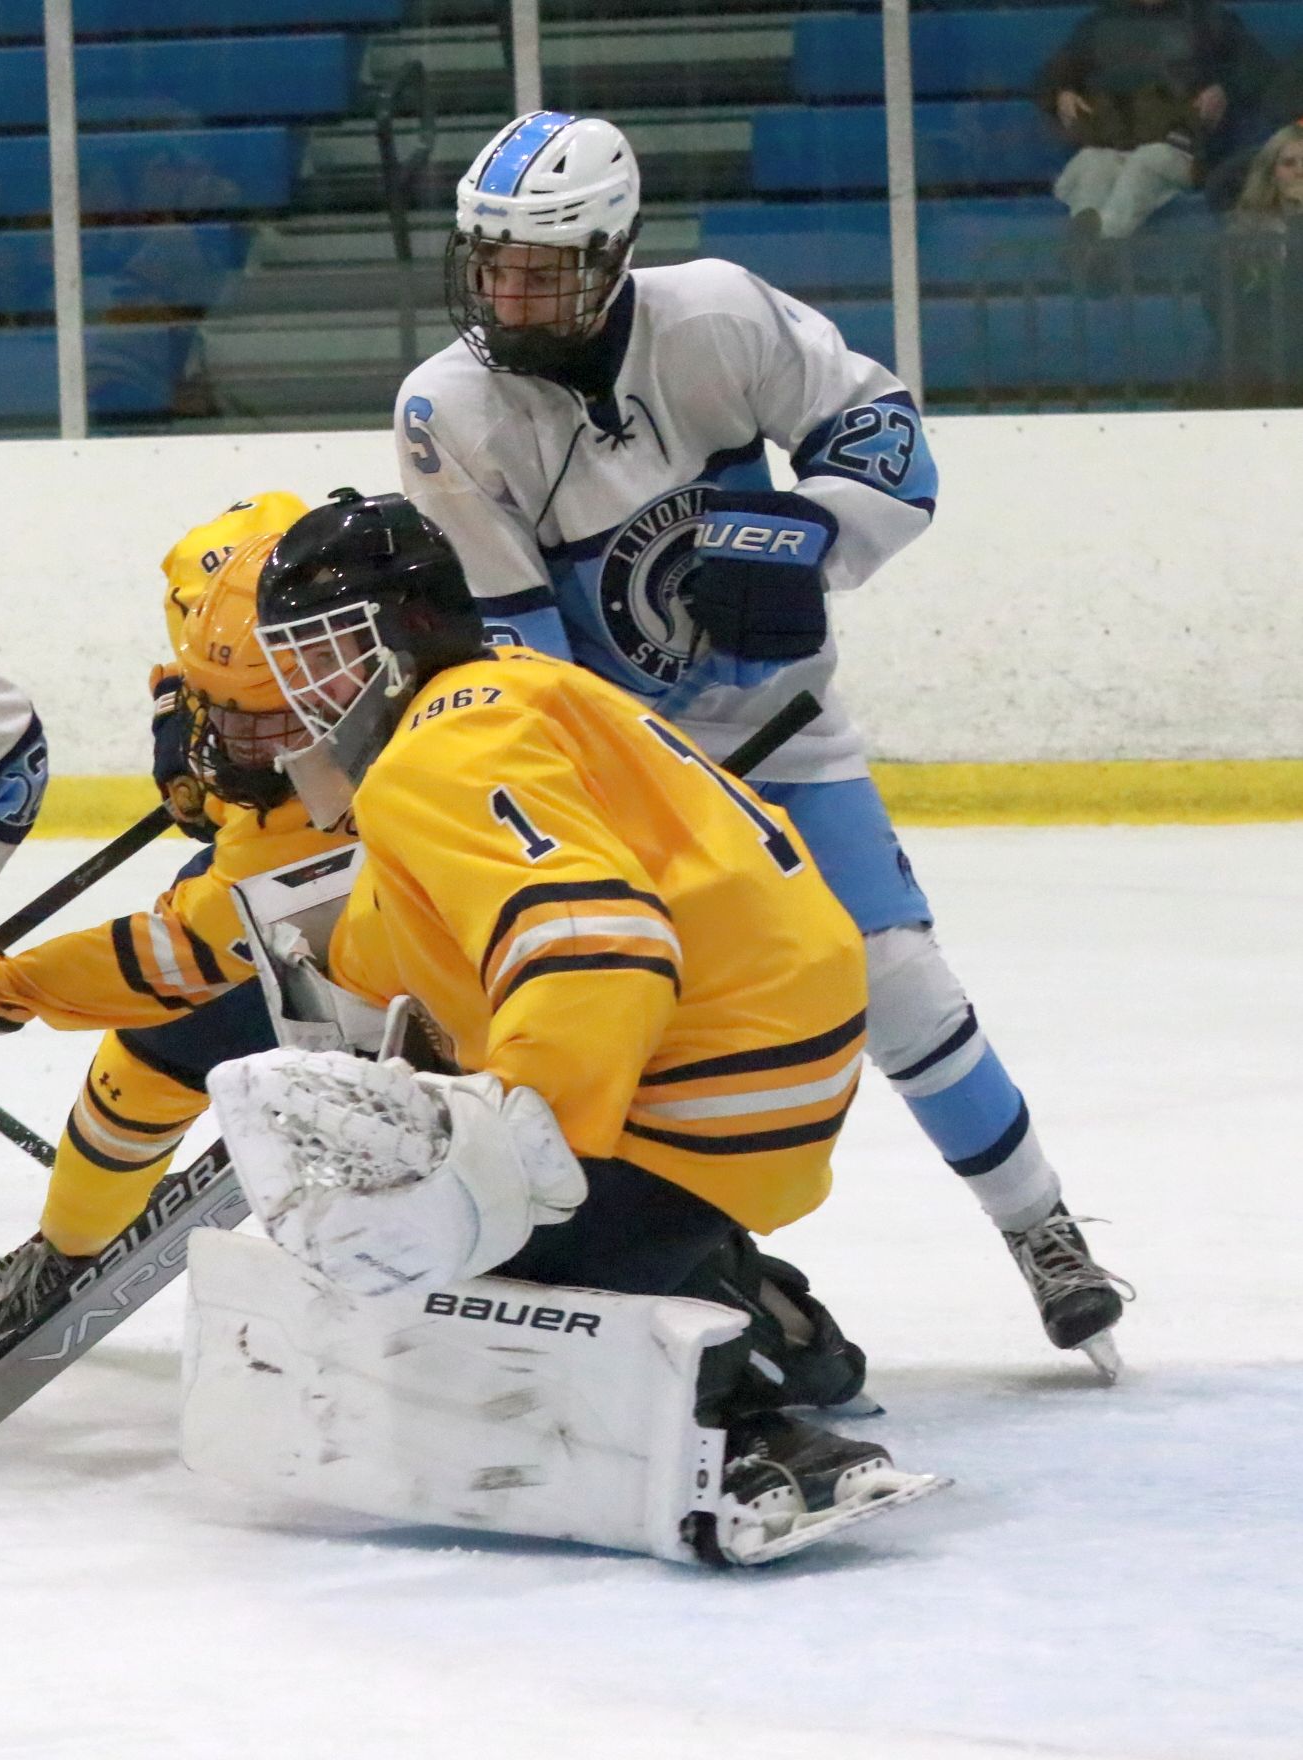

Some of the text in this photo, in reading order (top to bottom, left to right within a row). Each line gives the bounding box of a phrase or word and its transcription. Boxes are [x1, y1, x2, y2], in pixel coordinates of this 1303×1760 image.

[403, 395, 441, 473] S
[824, 405, 916, 488] 23
[612, 489, 706, 567] LIVONI
[693, 523, 807, 556] UER
[208, 641, 232, 667] 19
[409, 686, 503, 732] 1967
[489, 784, 561, 864] 1
[637, 714, 805, 879] 1
[423, 1291, 602, 1338] BAUER
